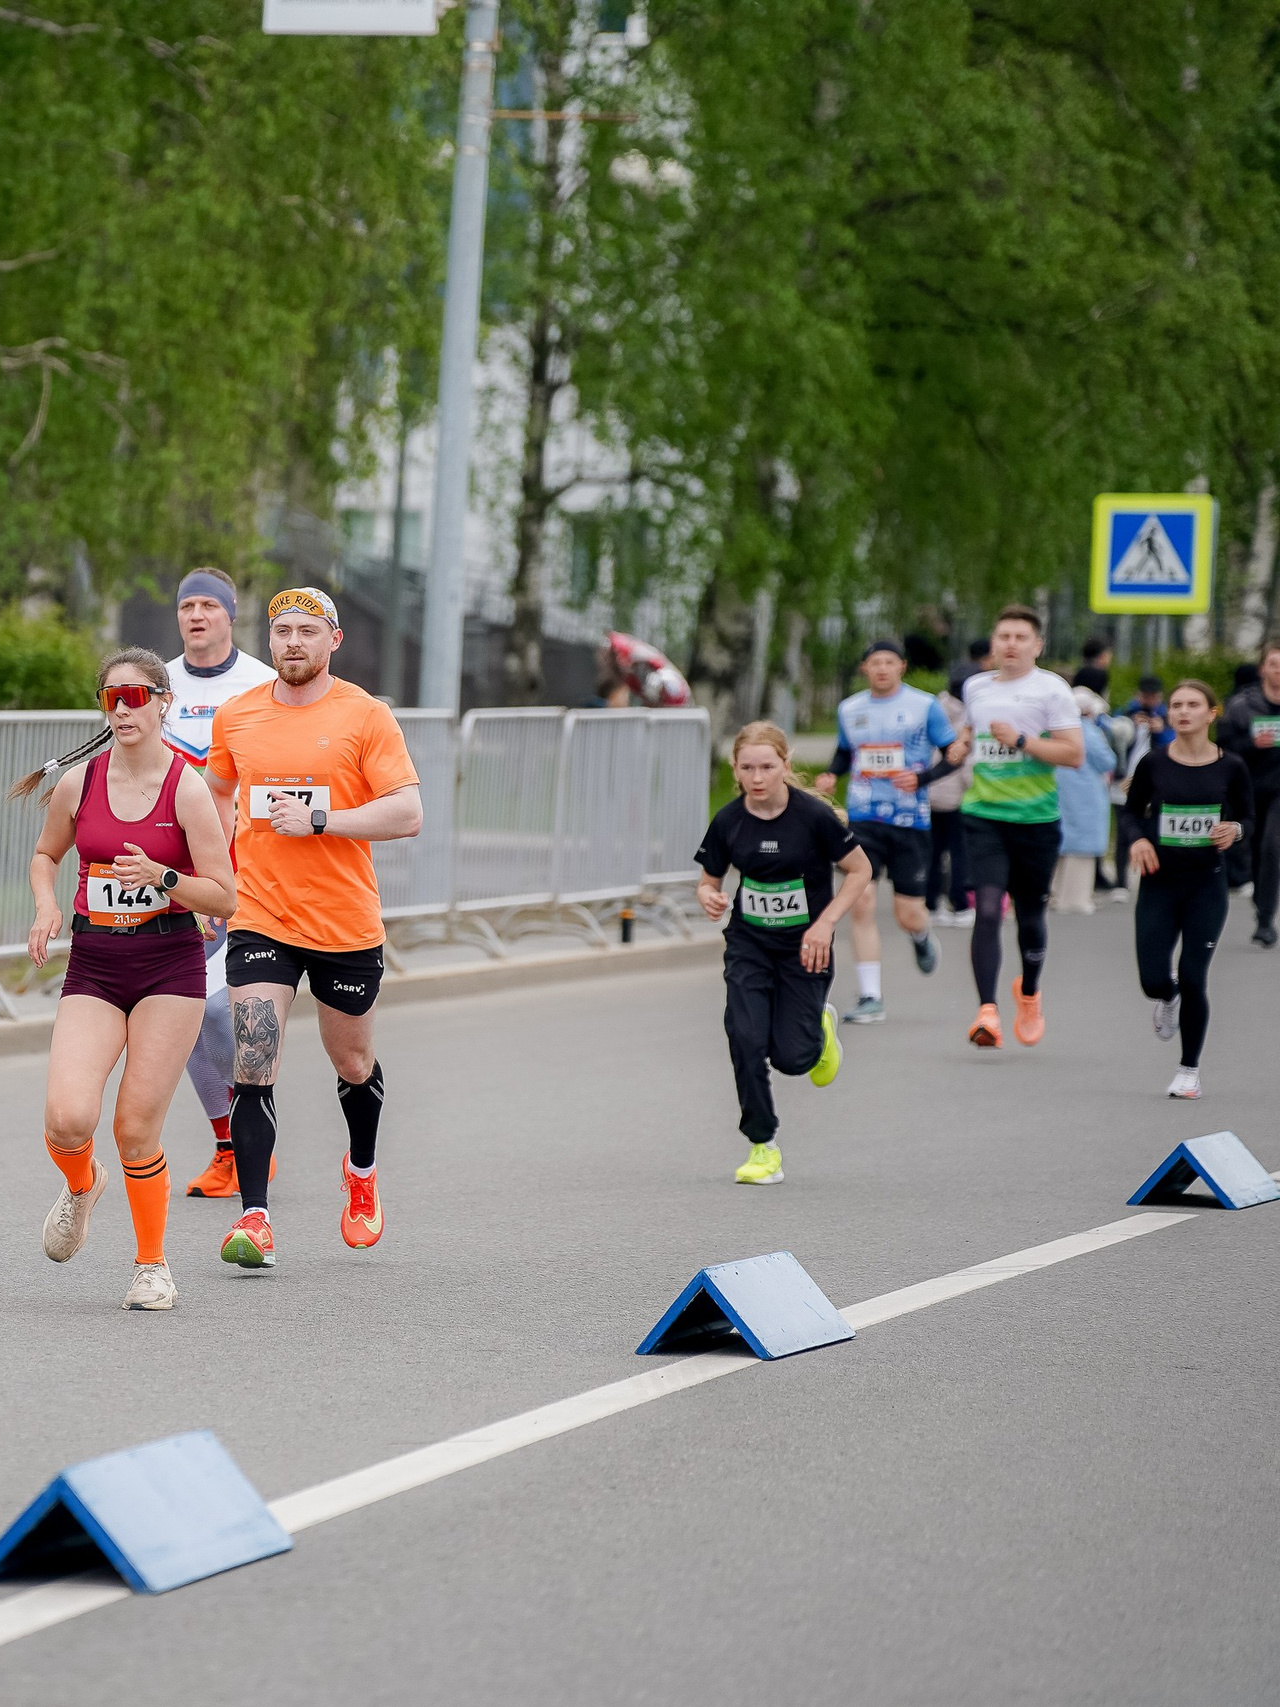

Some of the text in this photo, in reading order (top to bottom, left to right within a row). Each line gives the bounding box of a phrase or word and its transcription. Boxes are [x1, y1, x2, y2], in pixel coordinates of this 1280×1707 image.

[294, 595, 319, 612] RIDE
[1168, 817, 1214, 833] 1409
[748, 893, 801, 914] 1134
[248, 950, 273, 961] ASRV
[336, 983, 363, 994] ASRV
